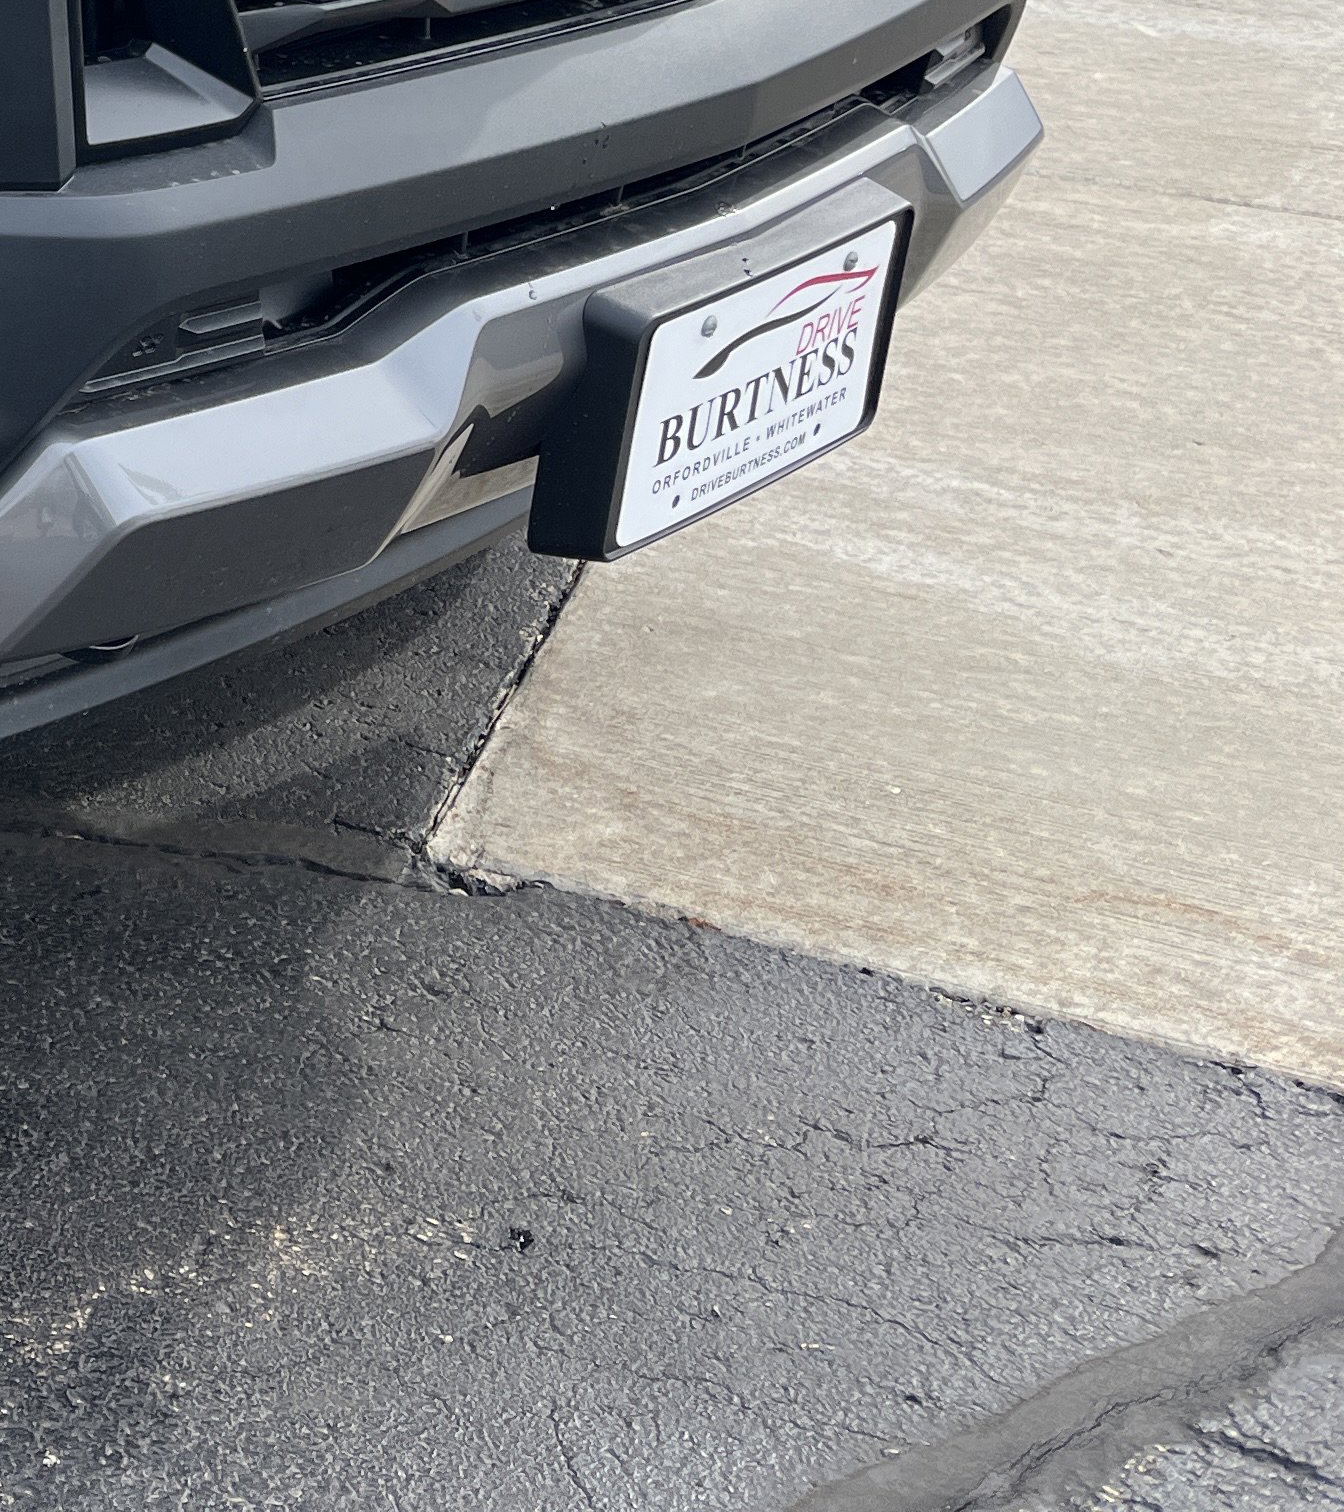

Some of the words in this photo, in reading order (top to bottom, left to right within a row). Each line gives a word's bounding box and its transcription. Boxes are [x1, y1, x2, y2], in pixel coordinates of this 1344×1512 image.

[795, 294, 867, 355] DRIVE
[651, 435, 751, 495] ORFORDVILLE
[765, 387, 848, 441] WHITEWATER
[653, 326, 859, 469] BURTNESS
[690, 432, 807, 502] DRIVEBURTNESS.COM
